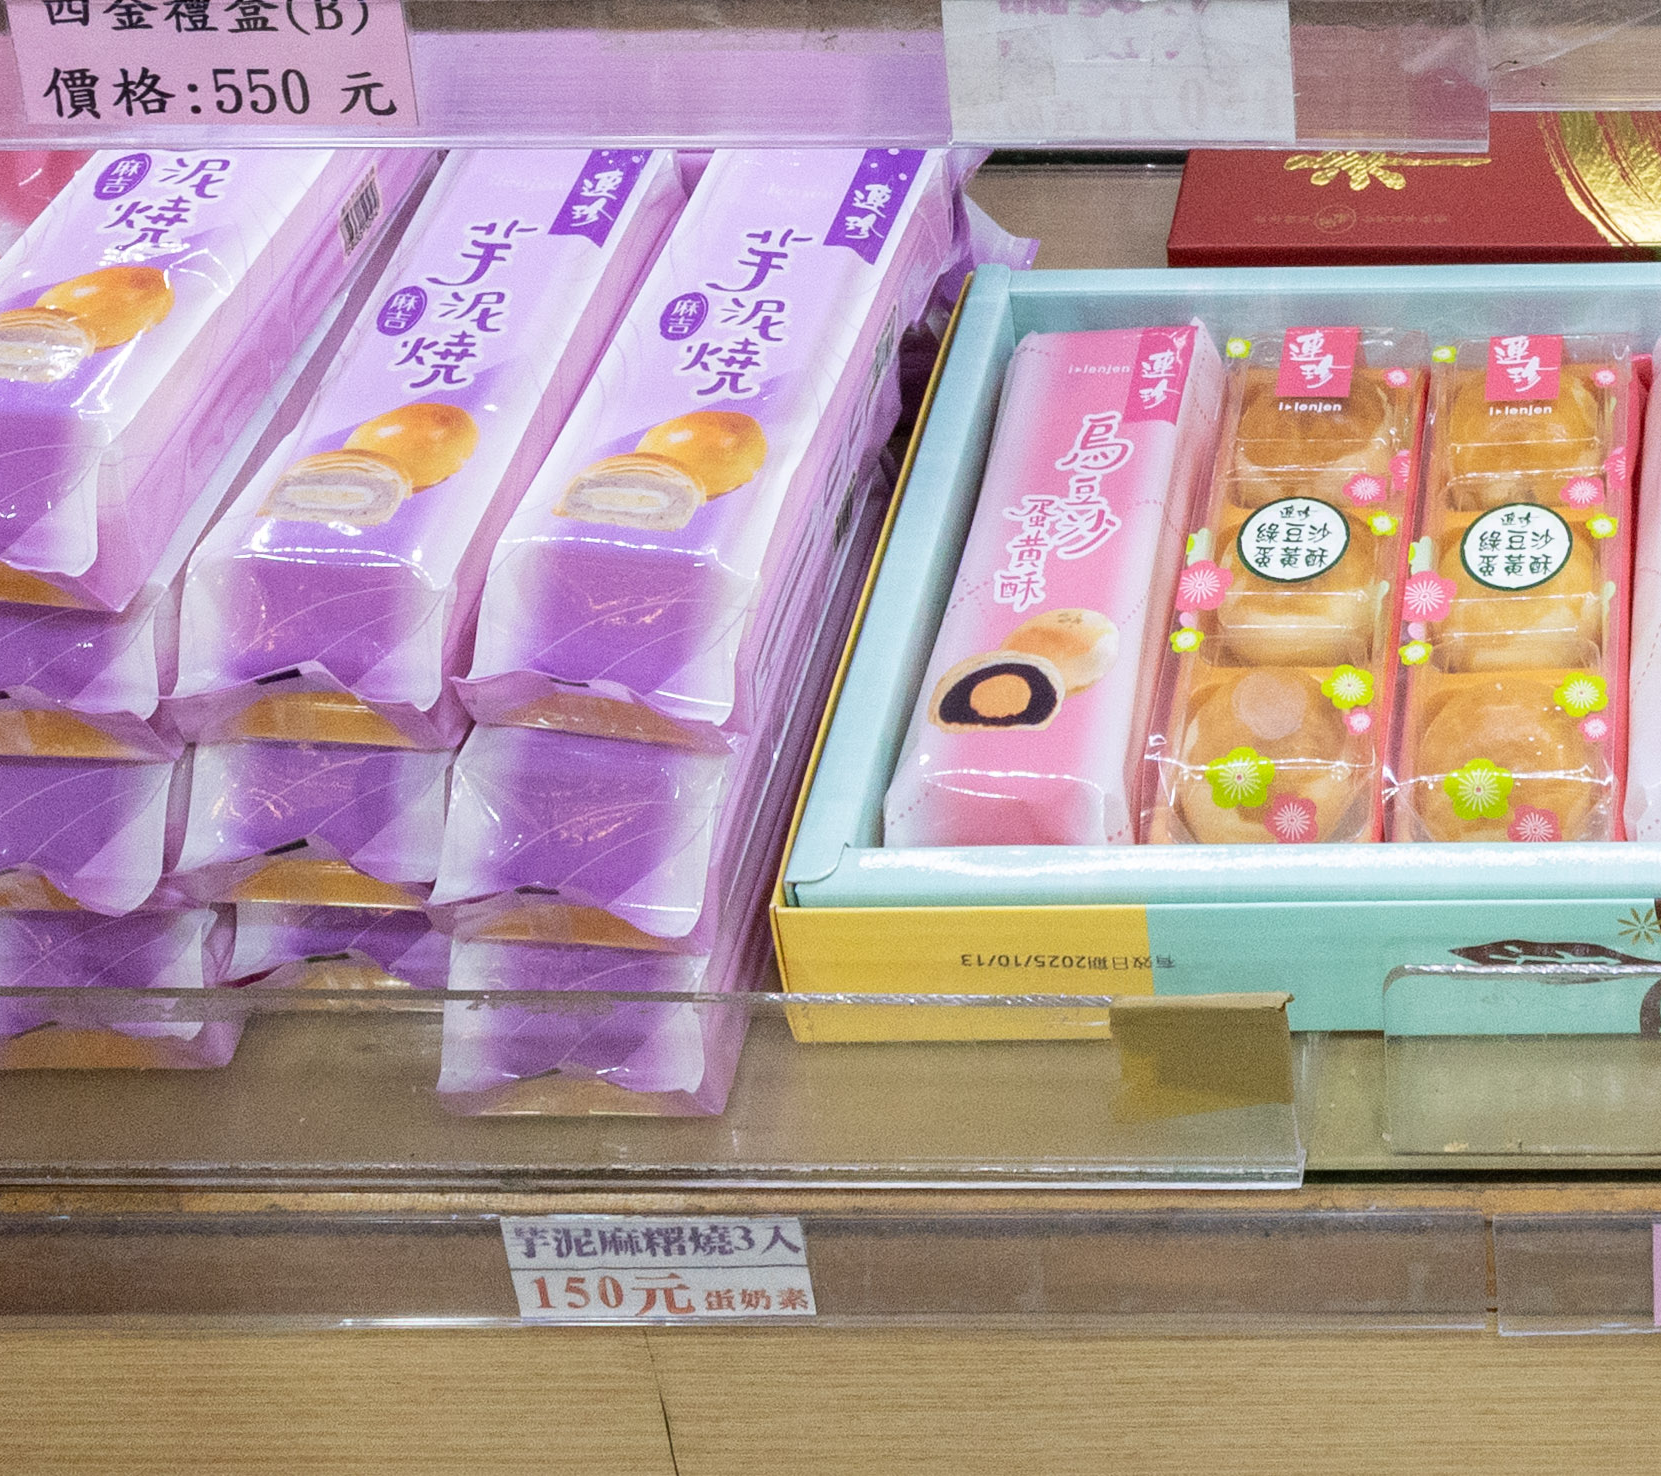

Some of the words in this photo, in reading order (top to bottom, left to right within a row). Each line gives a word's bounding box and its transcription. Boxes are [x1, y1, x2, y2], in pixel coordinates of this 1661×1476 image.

[570, 168, 623, 234] 連珍
[842, 183, 895, 241] 連珍
[383, 290, 418, 331] 麻吉
[395, 217, 540, 394] 芋泥燒
[667, 294, 701, 337] 麻吉
[676, 226, 812, 398] 芋泥燒
[1139, 353, 1181, 411] 連珍
[1287, 332, 1347, 391] 連珍
[1493, 335, 1559, 393] 連珍
[1055, 411, 1134, 561] 烏豆沙
[993, 494, 1059, 610] 蛋黃酥
[1253, 547, 1330, 571] 蛋黃酥
[1254, 523, 1335, 548] 綠豆沙
[1475, 528, 1556, 554] 綠豆沙
[1476, 552, 1556, 579] 蛋黃酥
[532, 1273, 696, 1318] 150元
[703, 1287, 810, 1312] 蛋奶素
